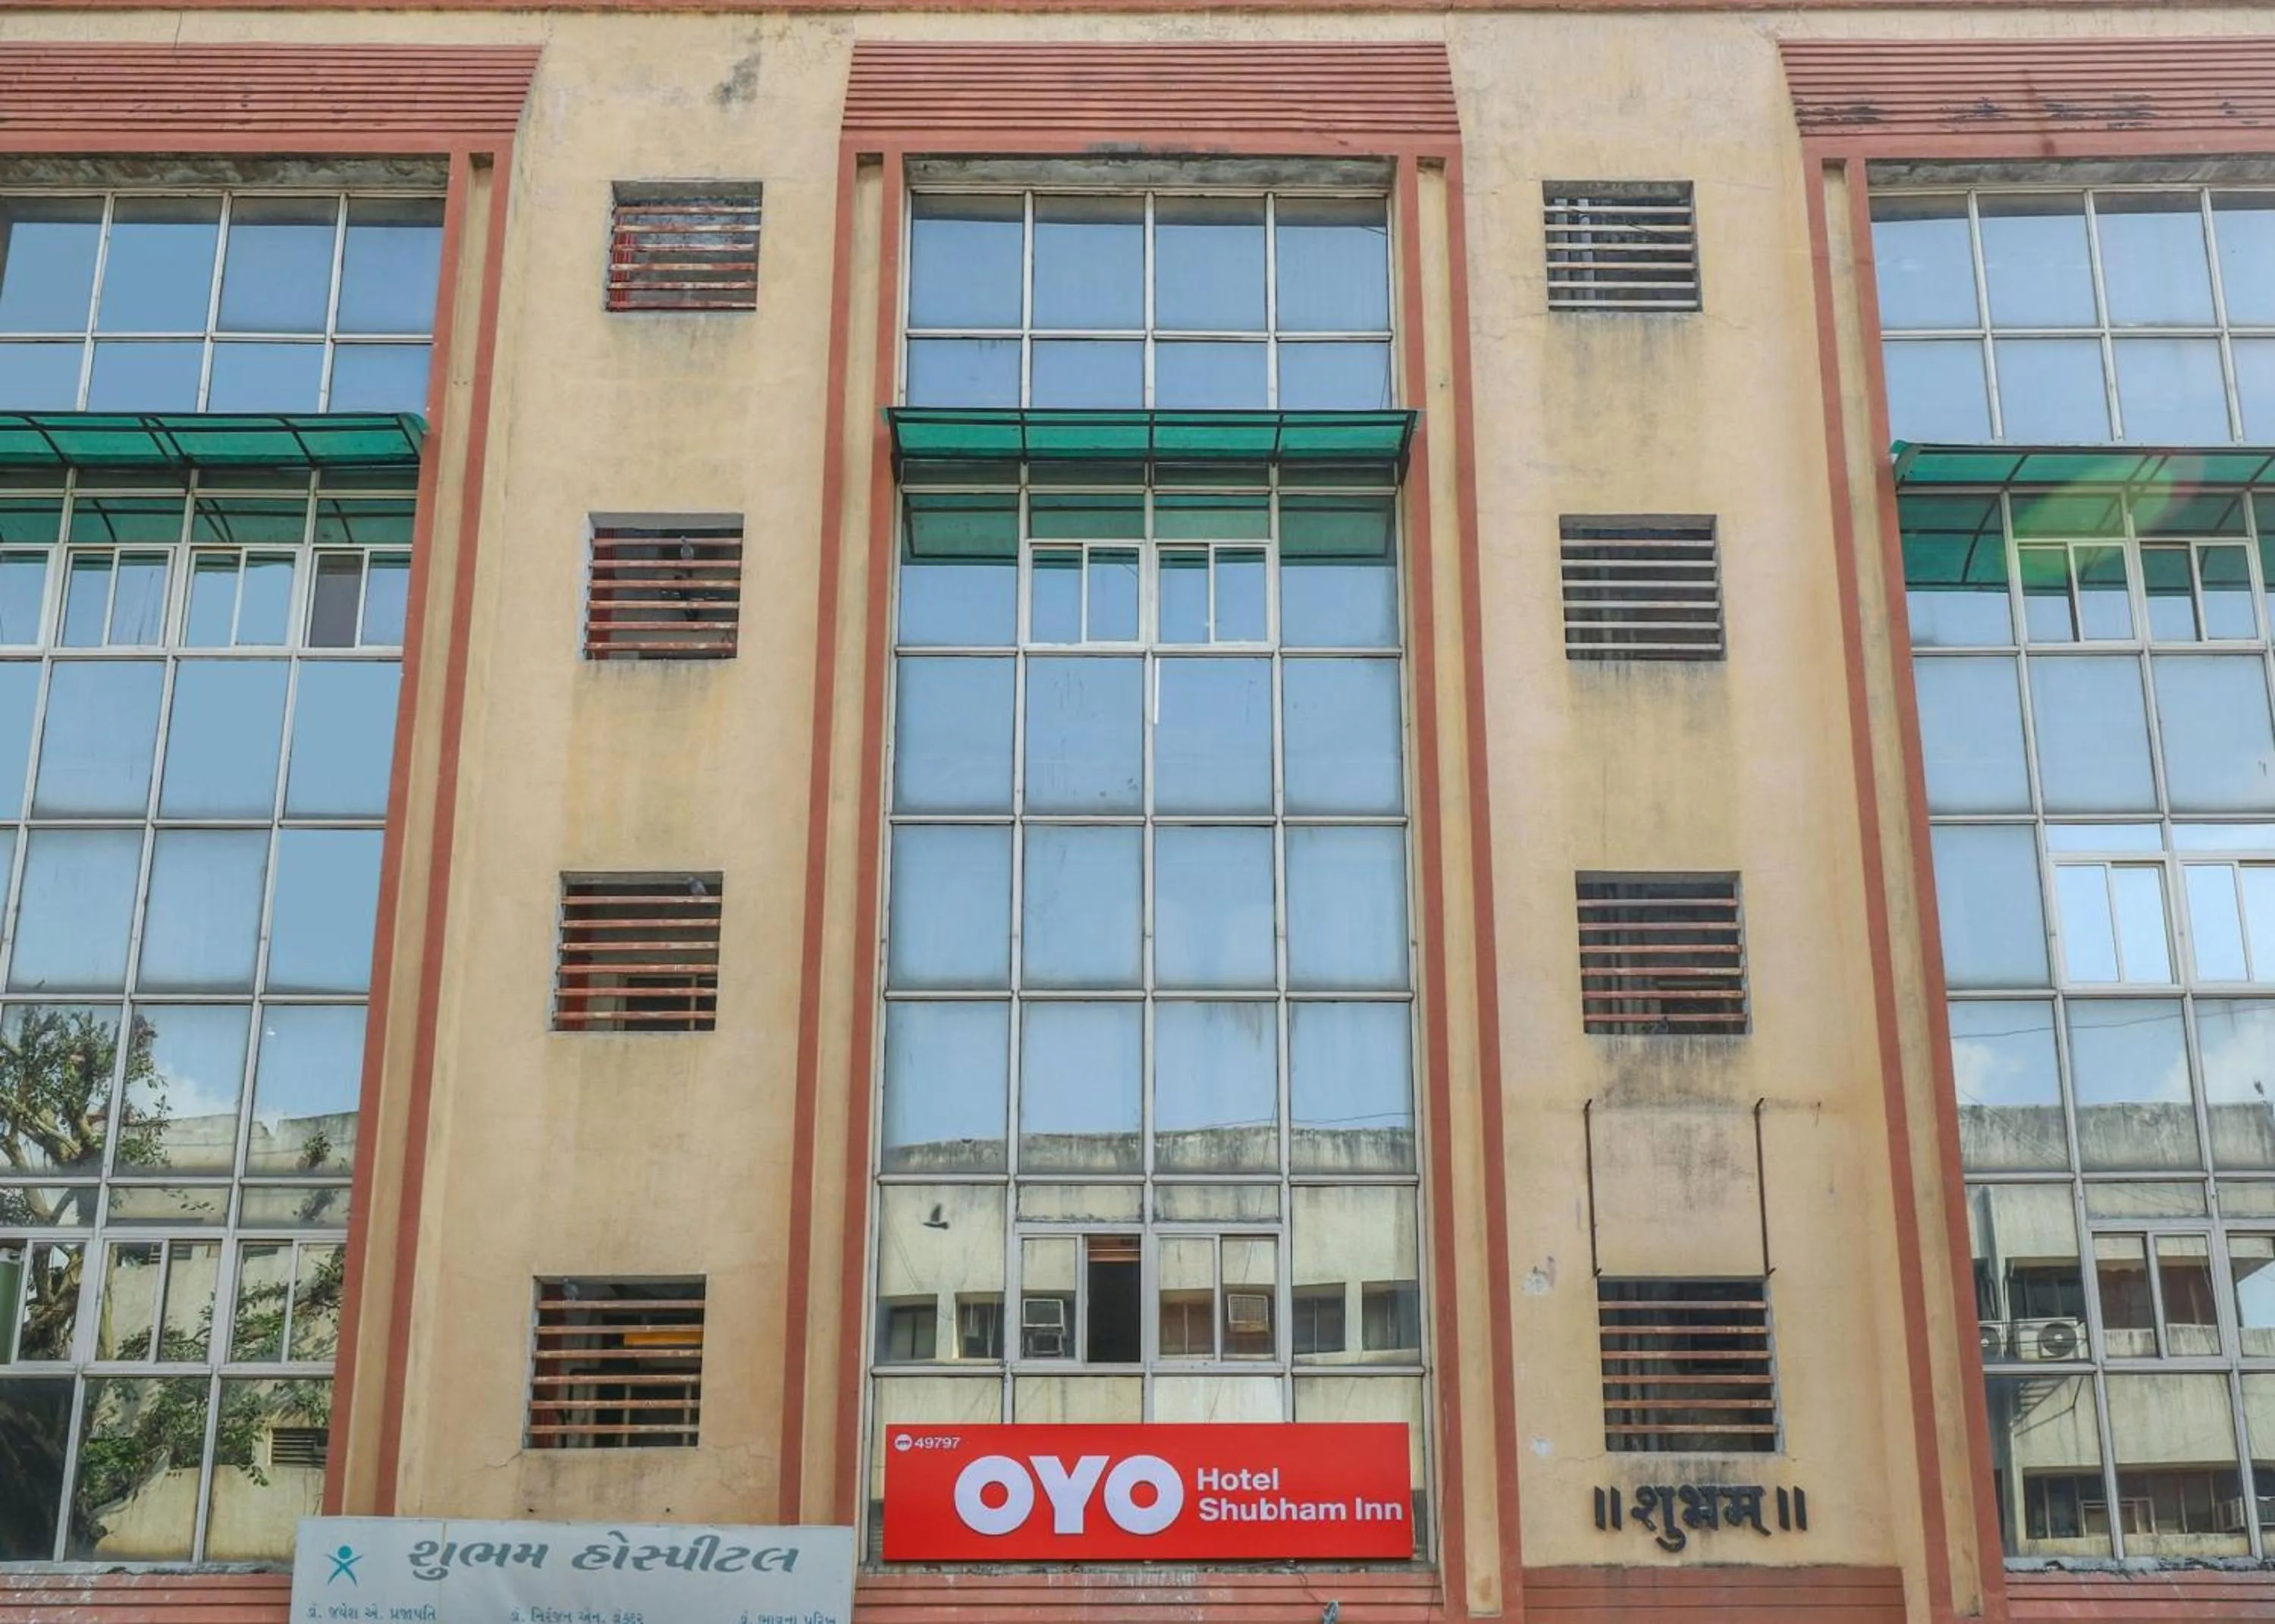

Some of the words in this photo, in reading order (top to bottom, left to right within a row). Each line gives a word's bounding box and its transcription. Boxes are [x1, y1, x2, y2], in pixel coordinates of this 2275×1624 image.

[914, 1436, 961, 1450] 49797
[1197, 1467, 1279, 1491] Hotel
[954, 1454, 1185, 1535] OYO
[1198, 1497, 1347, 1522] Shubham
[1354, 1497, 1403, 1521] Inn
[408, 1539, 548, 1581] શુભમ
[571, 1530, 799, 1574] હોસ્પીટલ
